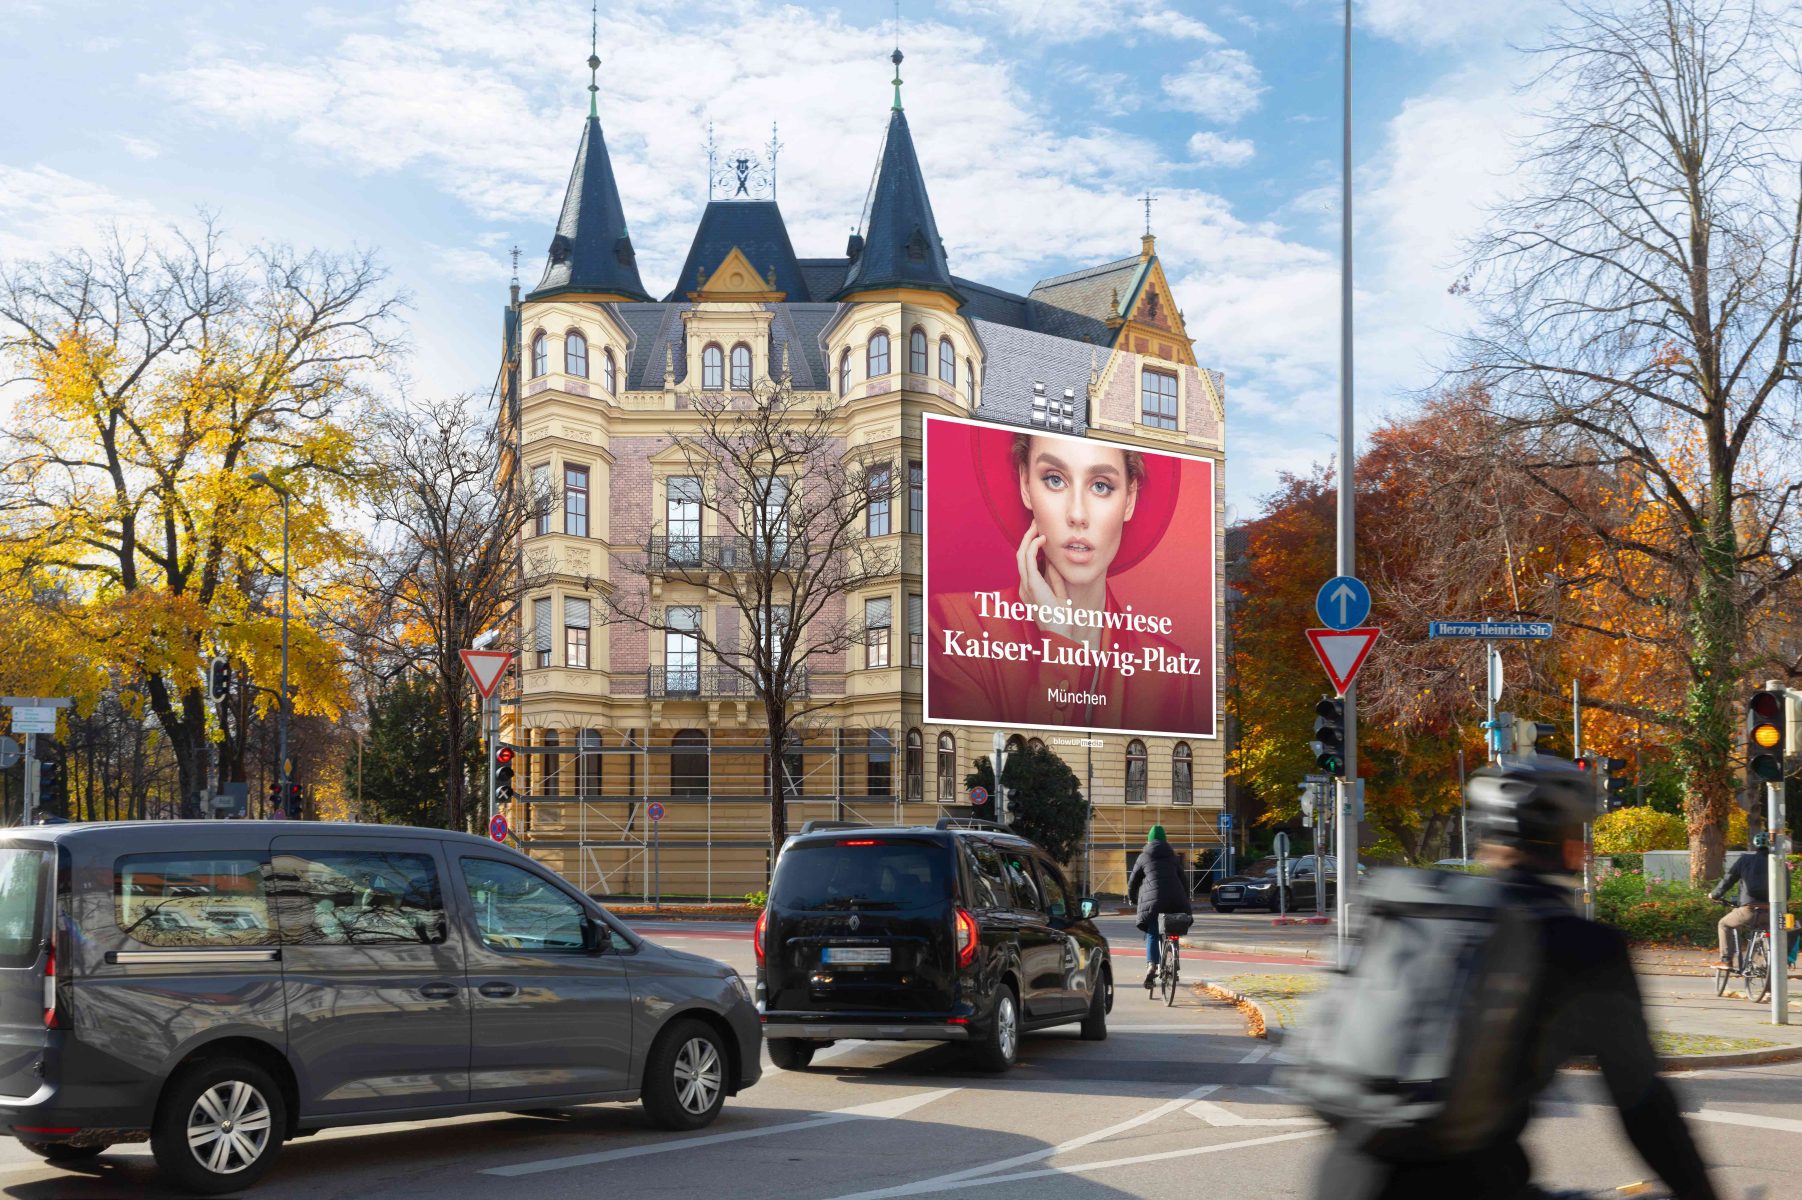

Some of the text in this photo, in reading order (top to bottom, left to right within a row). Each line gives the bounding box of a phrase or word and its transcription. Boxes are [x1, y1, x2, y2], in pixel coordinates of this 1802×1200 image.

[974, 591, 1172, 634] Theresienwiese
[1439, 623, 1548, 636] Herzog-Heinrich-Str.
[942, 629, 1201, 676] Kaiser-Ludwig-Platz
[1047, 687, 1107, 706] München
